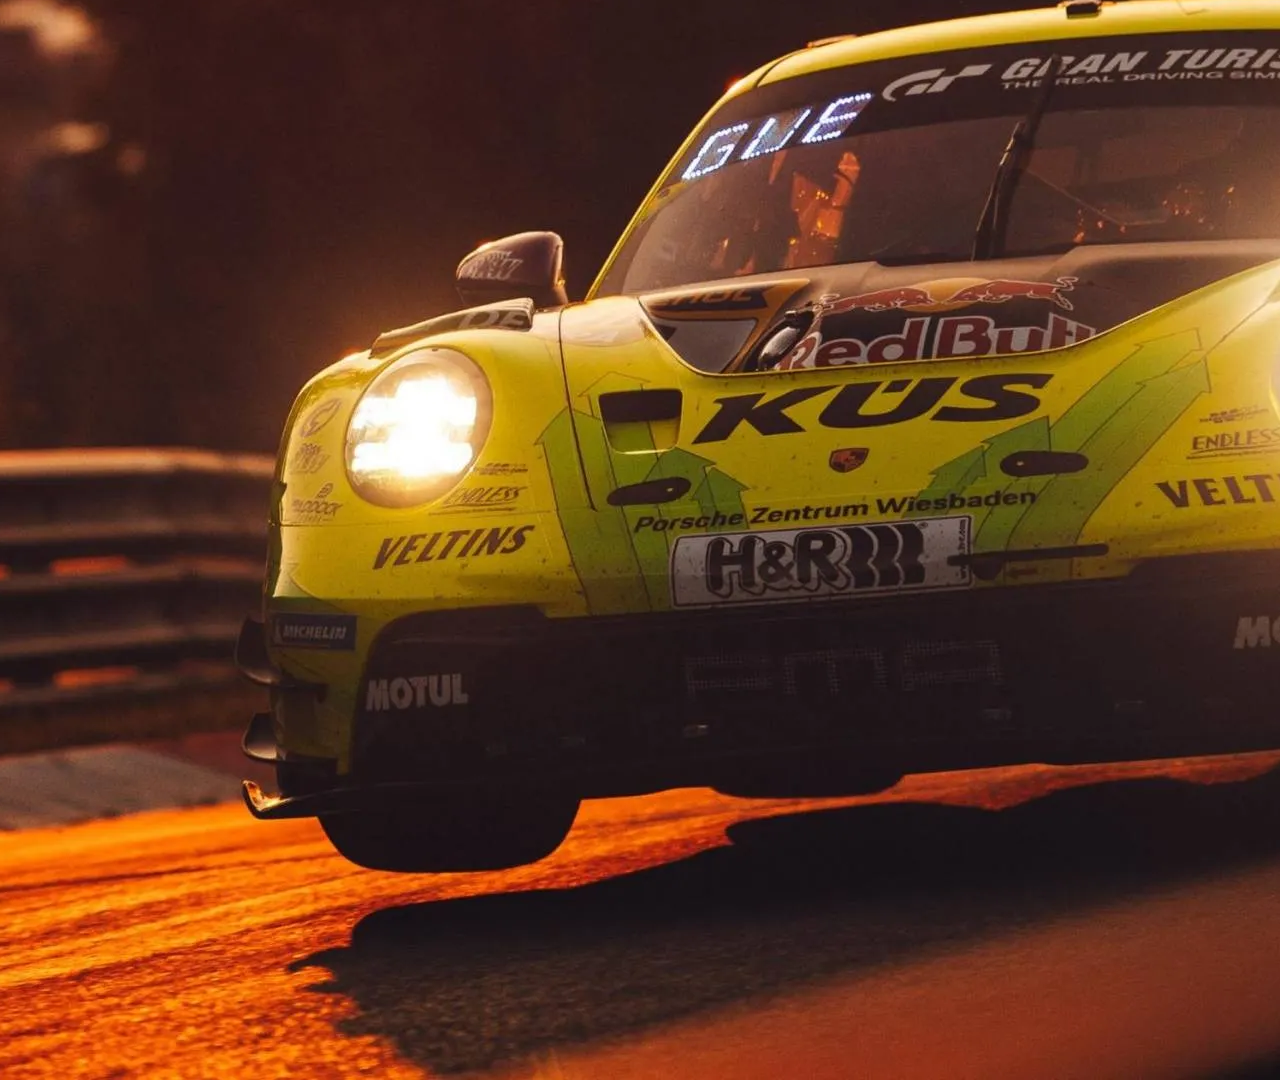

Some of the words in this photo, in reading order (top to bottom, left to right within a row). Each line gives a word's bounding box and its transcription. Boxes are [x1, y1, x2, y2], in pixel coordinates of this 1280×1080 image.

[1001, 79, 1043, 90] THE
[1055, 74, 1115, 87] REAL
[1122, 71, 1224, 83] DRIVING
[692, 374, 1055, 445] KÜS
[633, 513, 745, 533] Porsche
[750, 503, 869, 525] Zentrum
[875, 489, 1038, 514] Wiesbaden
[372, 525, 536, 570] VELTINS
[282, 624, 347, 640] MICHELIN
[366, 673, 469, 712] MOTUL
